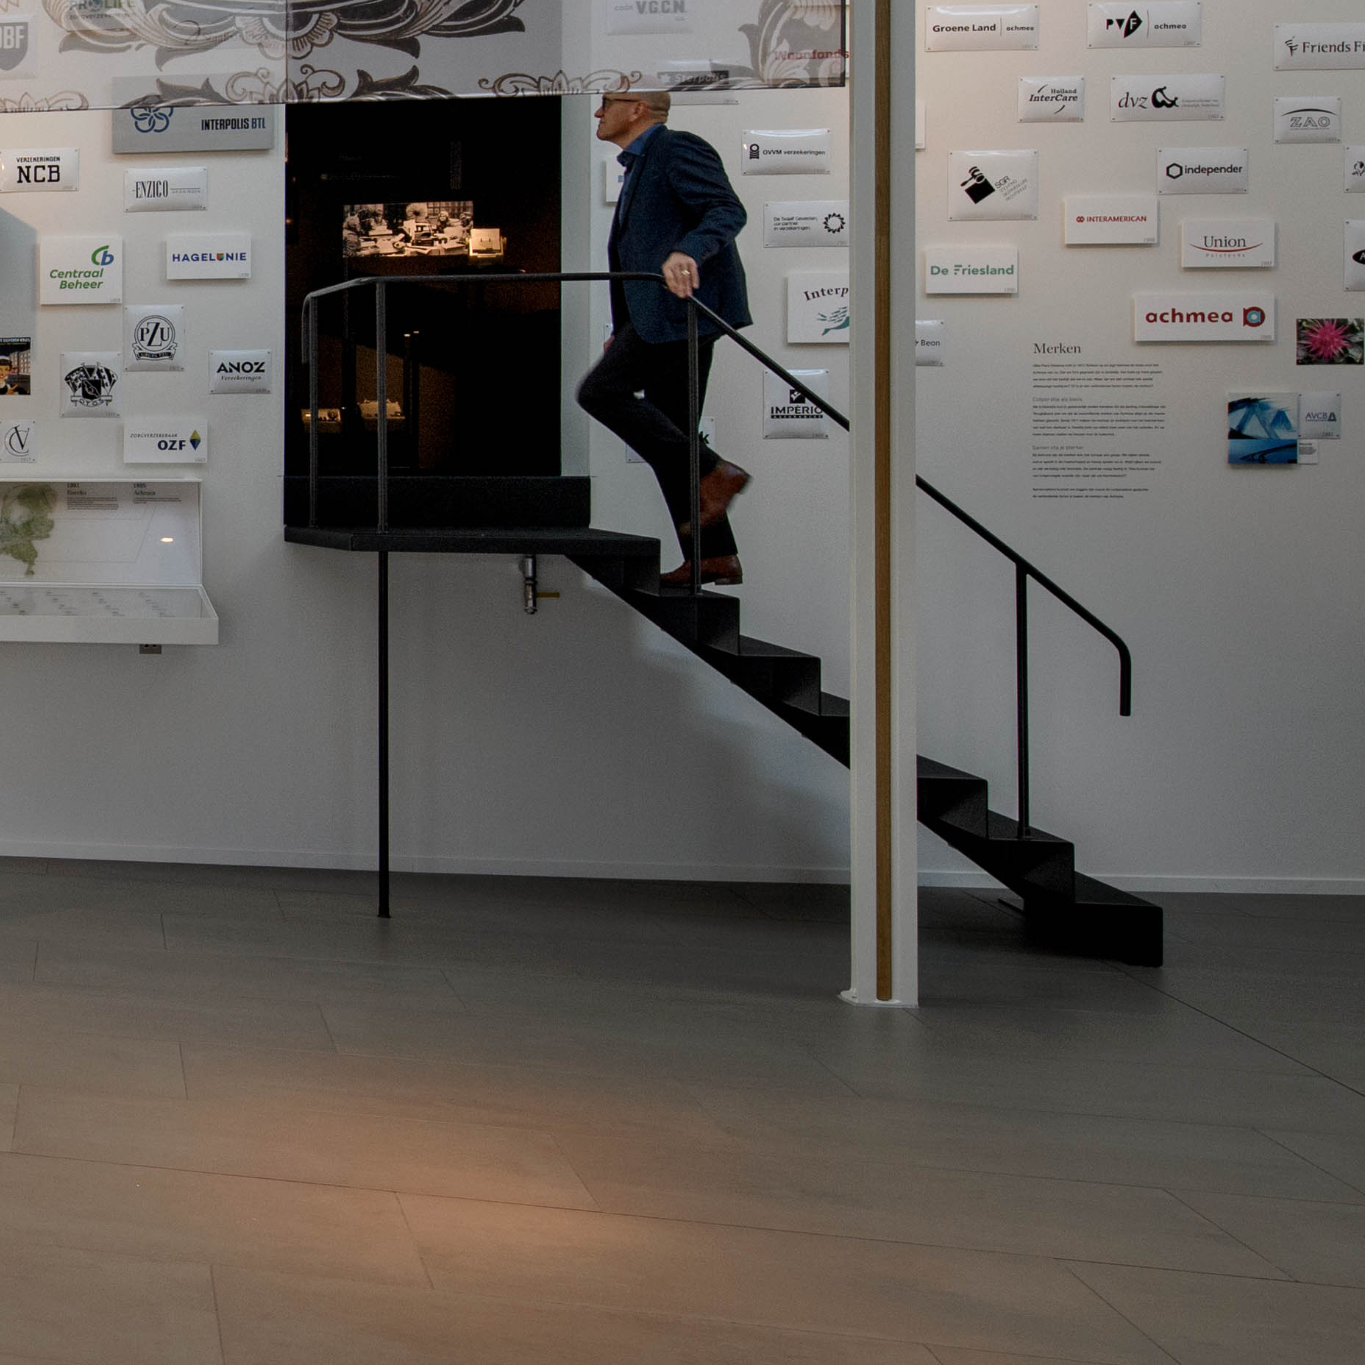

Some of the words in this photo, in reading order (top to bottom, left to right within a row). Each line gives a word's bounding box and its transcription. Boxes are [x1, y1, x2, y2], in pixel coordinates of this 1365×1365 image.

[933, 24, 970, 33] Groene
[972, 24, 996, 32] Land
[1302, 41, 1351, 53] Friends
[1029, 94, 1078, 102] InterCare
[1118, 92, 1147, 110] dvz
[201, 118, 249, 131] INTERPOLIS
[251, 118, 267, 129] BTL
[1290, 116, 1331, 128] ZAO
[17, 165, 61, 184] NCB
[1184, 164, 1243, 176] independer
[135, 180, 169, 199] ENZICO
[1203, 236, 1247, 248] Union
[49, 269, 103, 280] Centraal
[931, 266, 949, 276] De
[953, 264, 1015, 276] Friesland
[59, 280, 103, 290] Beheer
[1145, 308, 1233, 323] achmea
[139, 322, 170, 347] PZU
[1033, 342, 1081, 355] Merken
[216, 361, 265, 374] ANOZ
[221, 375, 262, 383] Verzekeringen
[1305, 412, 1327, 420] AVCB
[157, 440, 186, 451] OZF
